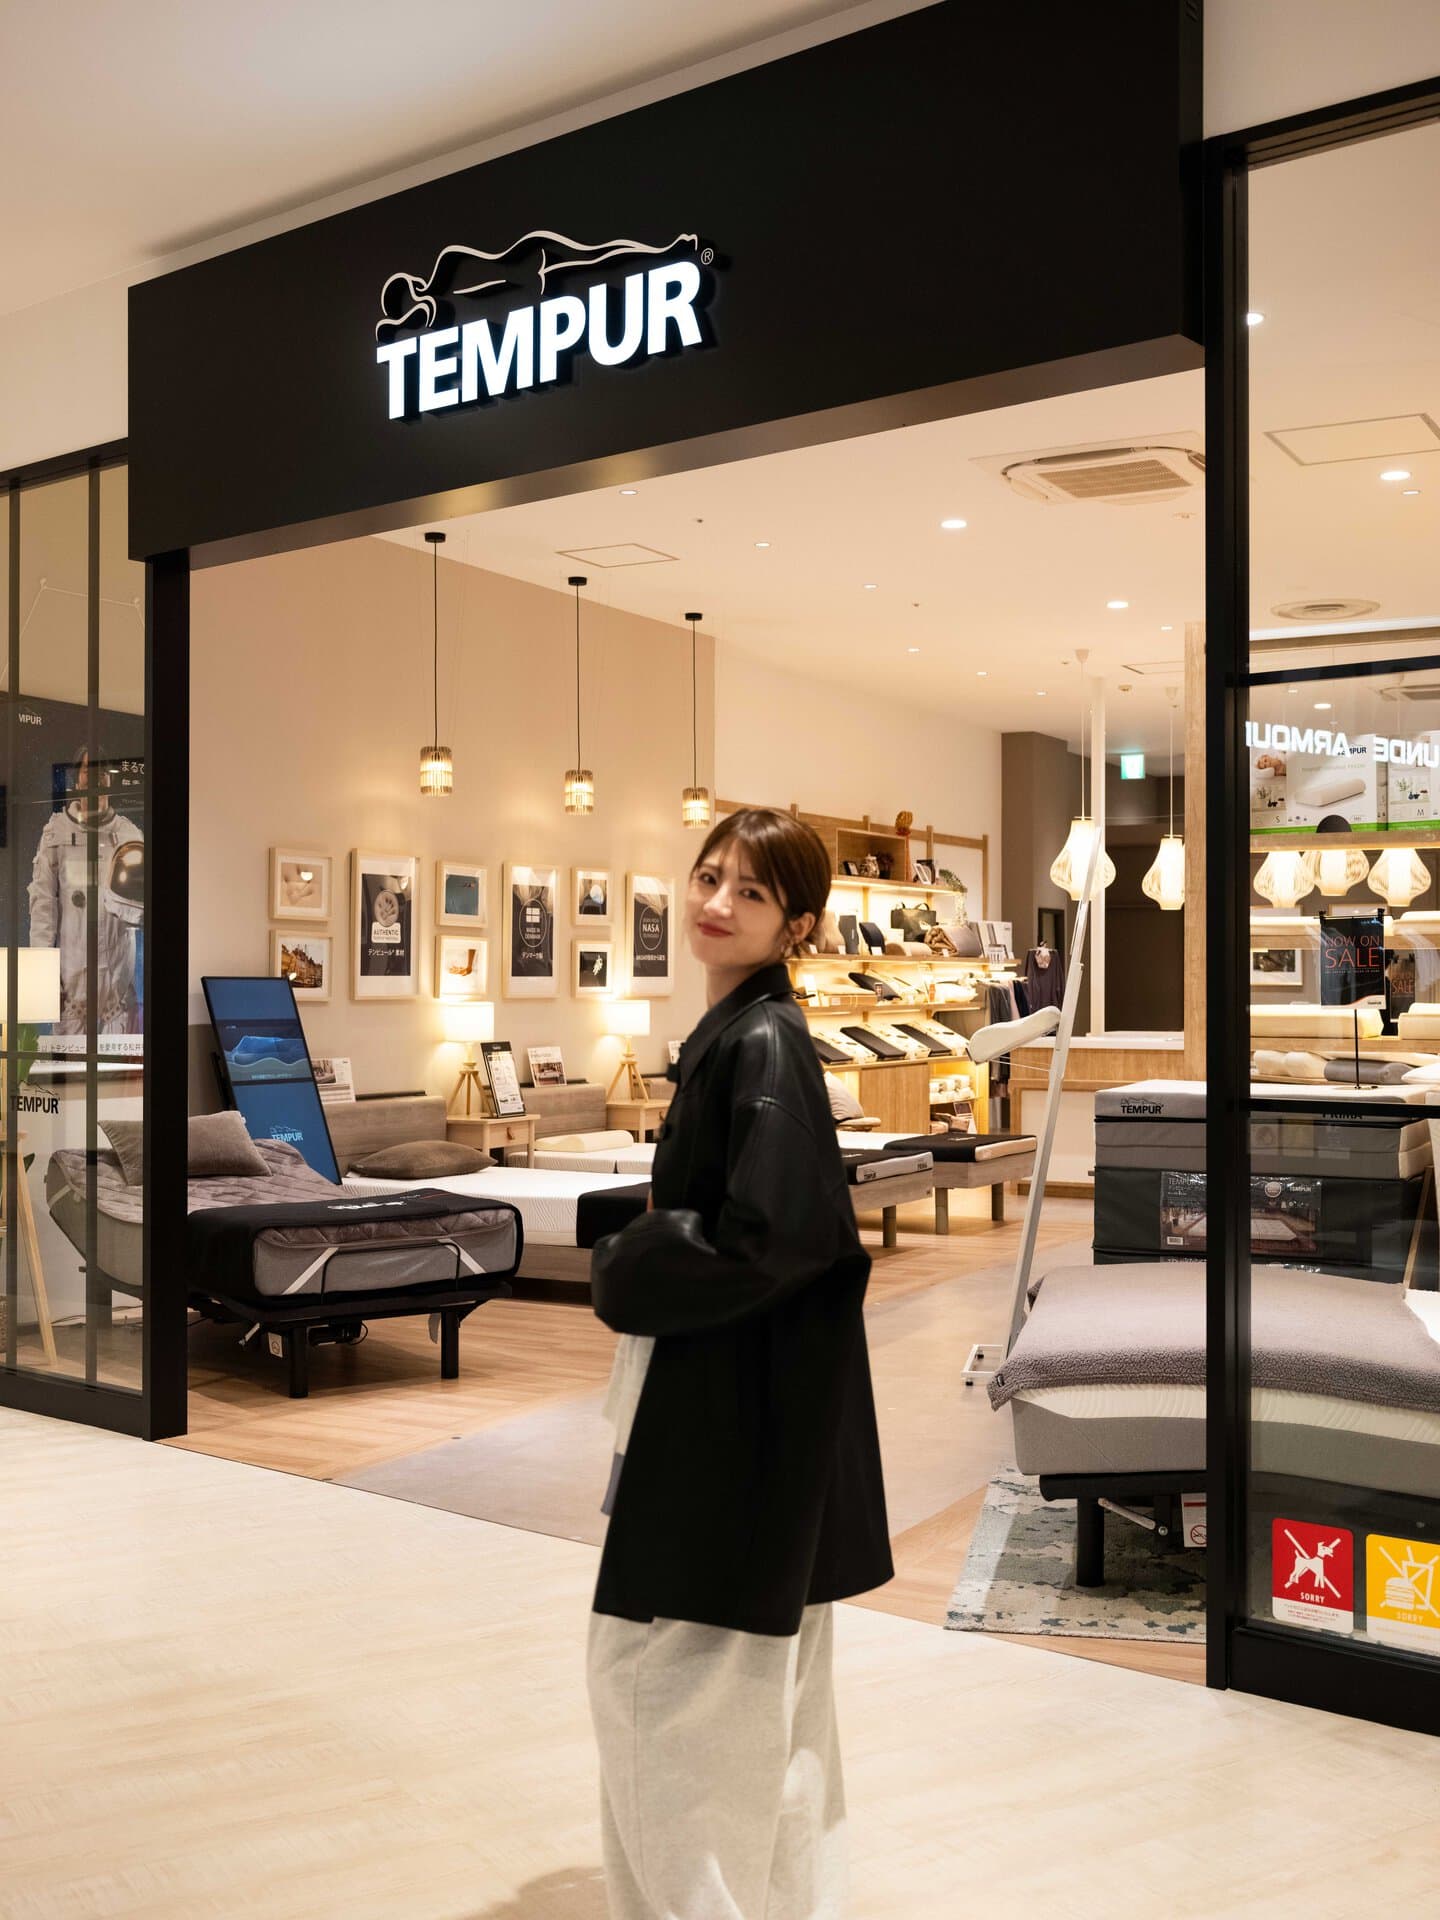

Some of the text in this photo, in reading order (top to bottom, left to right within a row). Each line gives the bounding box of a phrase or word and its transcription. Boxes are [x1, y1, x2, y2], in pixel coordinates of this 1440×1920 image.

[376, 261, 702, 420] TEMPUR
[642, 923, 660, 933] NASA
[1327, 935, 1380, 947] NOW ON
[1325, 947, 1381, 969] SALE
[10, 1095, 60, 1114] TEMPUR
[1120, 1104, 1163, 1115] TEMPUR
[1300, 1591, 1326, 1604] SORRY
[1396, 1611, 1424, 1624] SORRY
